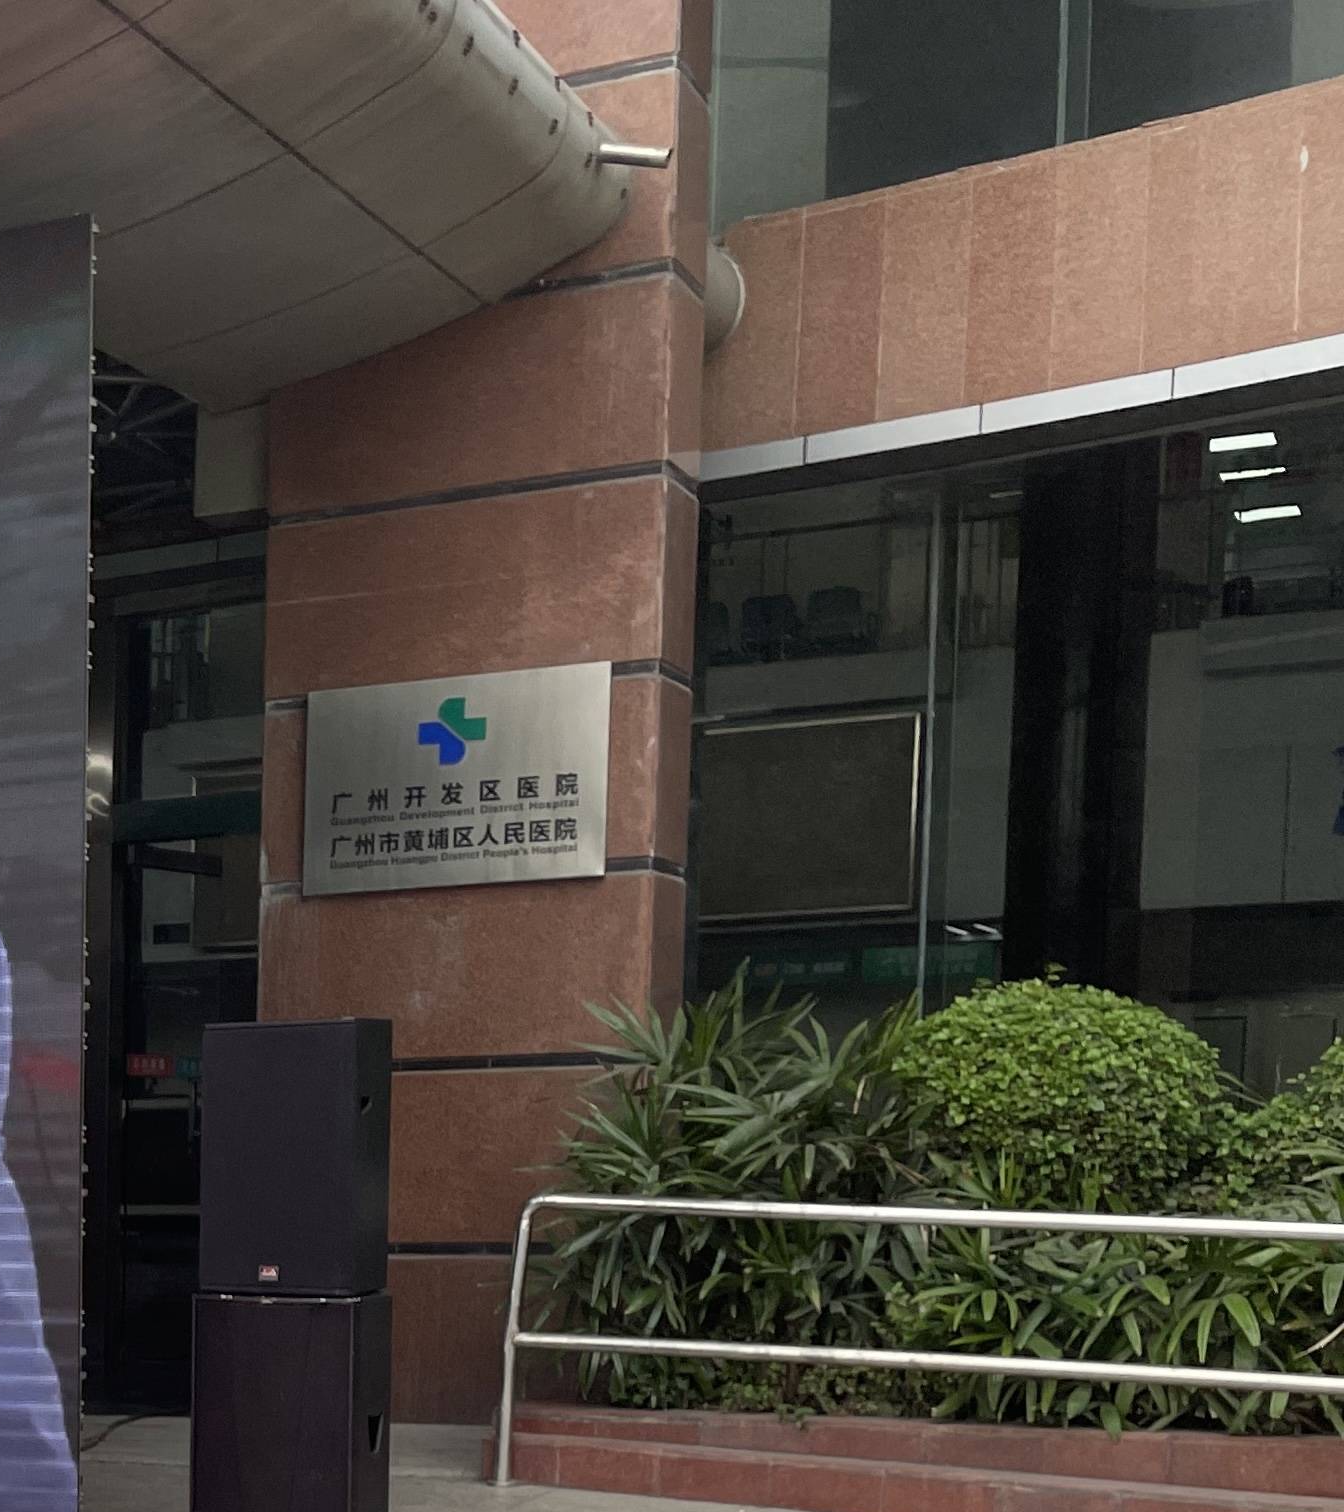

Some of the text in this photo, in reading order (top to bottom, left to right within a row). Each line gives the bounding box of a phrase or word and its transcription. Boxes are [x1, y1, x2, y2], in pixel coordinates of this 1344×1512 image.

[331, 773, 579, 814] 广州开发区医院
[330, 799, 580, 826] Guangzhou Development District Hospital
[330, 818, 578, 858] 广州市黄埔区人民医院
[330, 858, 389, 870] Guangzhou
[391, 854, 438, 867] Huangpu
[441, 850, 480, 862] District
[531, 843, 578, 856] Hospital
